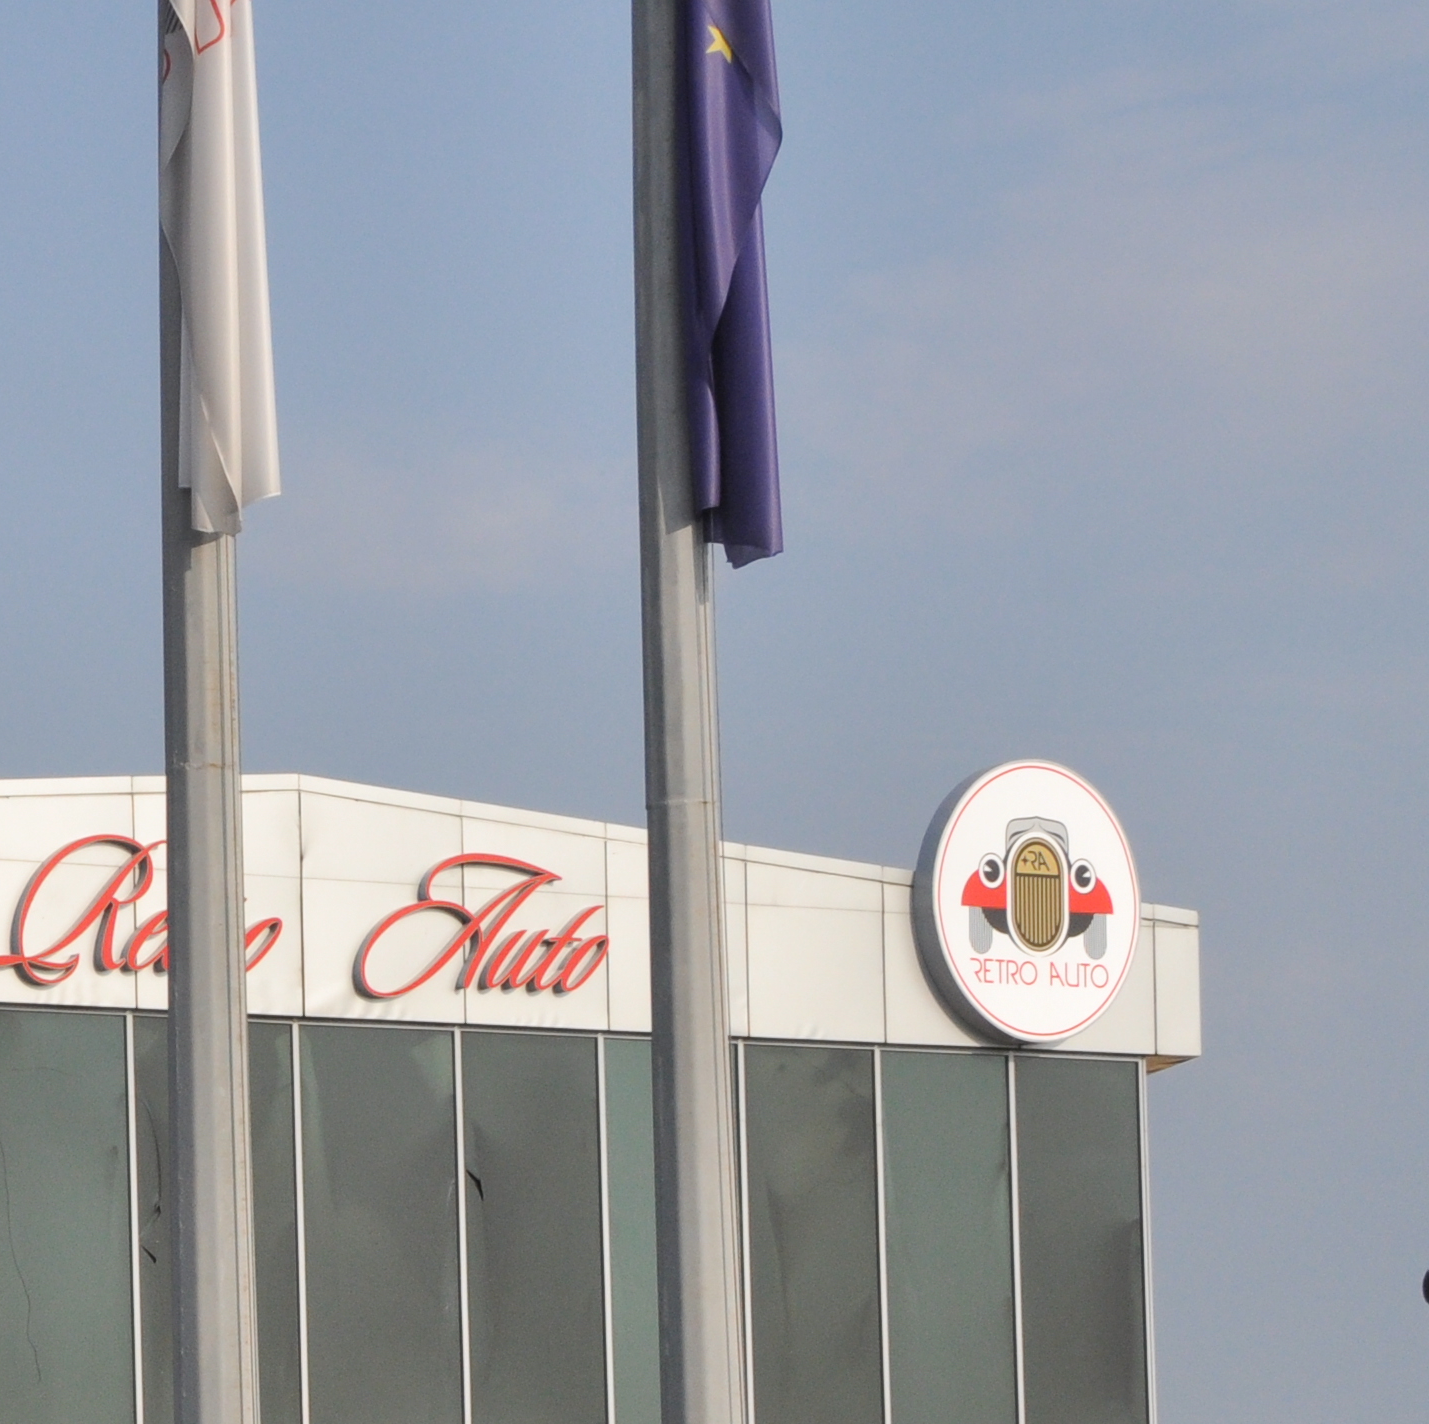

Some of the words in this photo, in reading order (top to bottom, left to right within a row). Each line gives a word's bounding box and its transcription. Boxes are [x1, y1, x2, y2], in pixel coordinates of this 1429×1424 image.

[357, 852, 610, 999] Auto
[969, 957, 1038, 986] RETRO
[1049, 961, 1109, 989] AUTO
